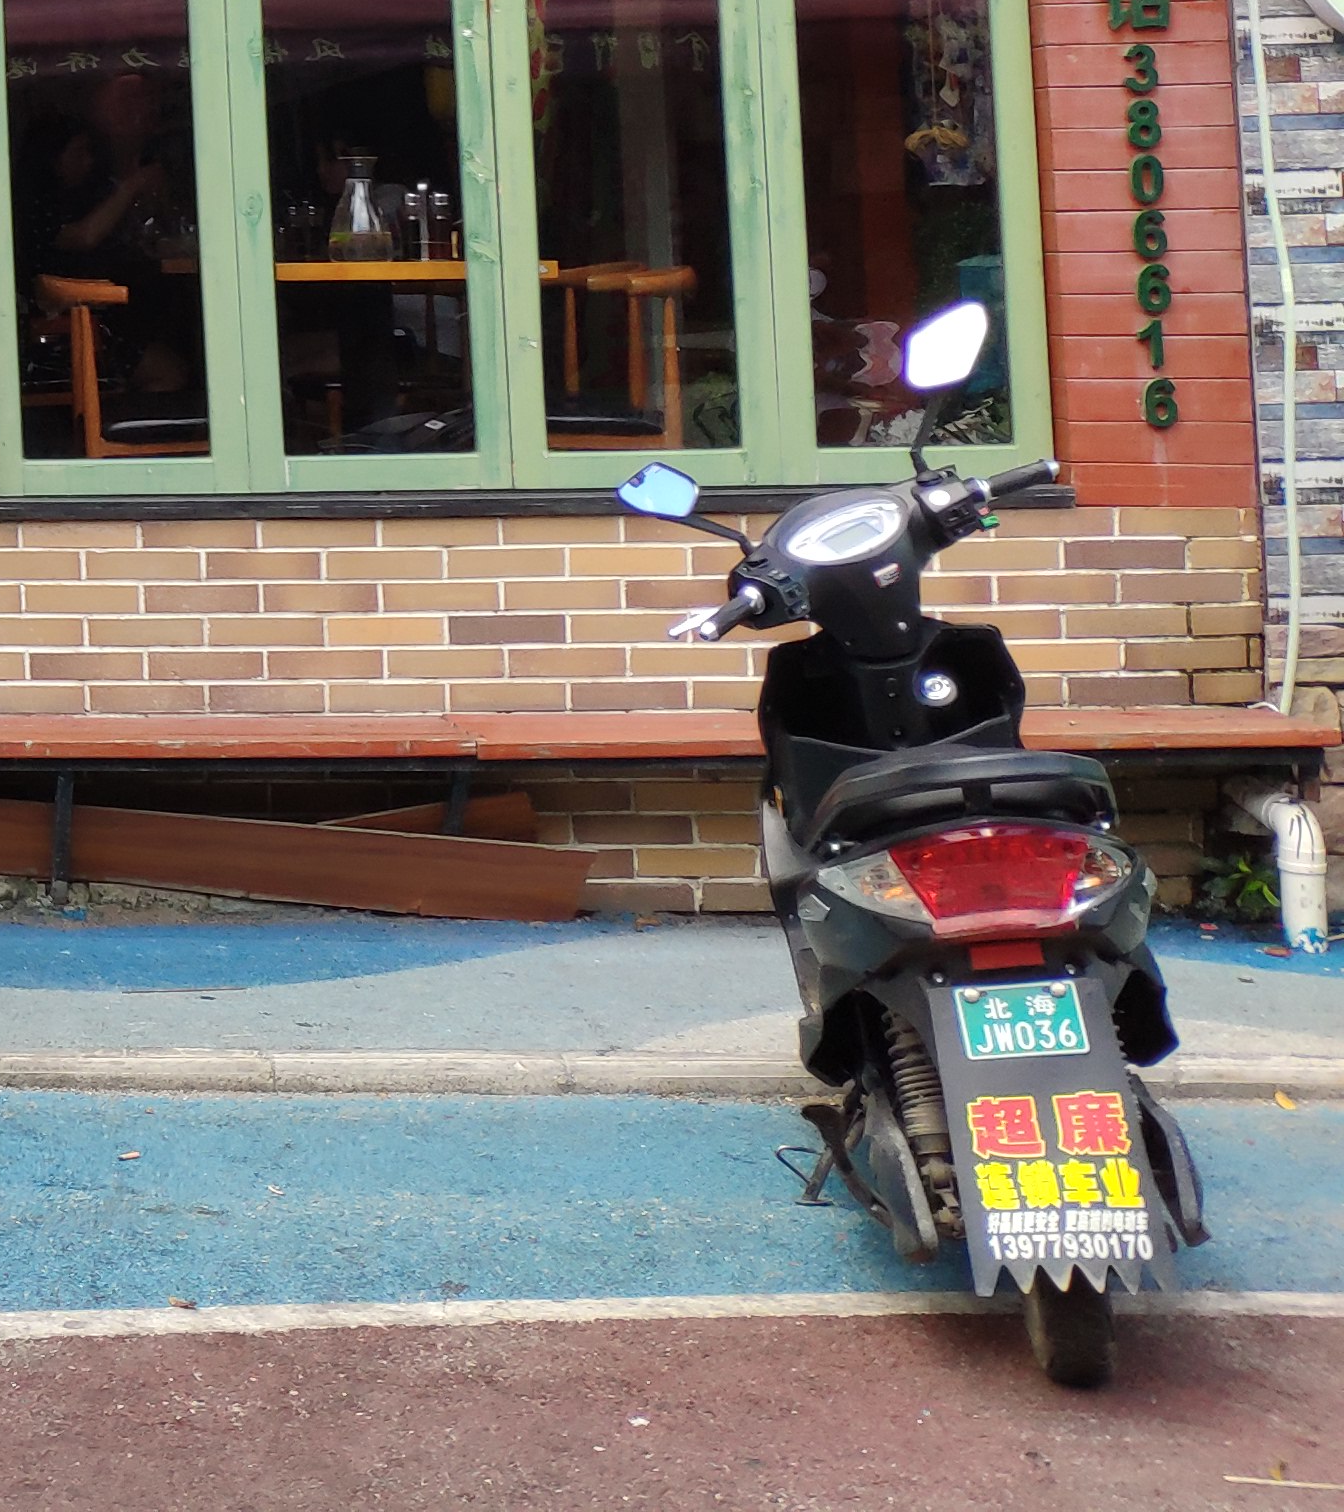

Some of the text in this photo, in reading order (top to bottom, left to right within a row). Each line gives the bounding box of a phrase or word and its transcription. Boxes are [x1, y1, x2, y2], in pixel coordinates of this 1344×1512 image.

[984, 994, 1056, 1020] 北海
[976, 1020, 1078, 1054] JW036
[967, 1091, 1131, 1159] 超廉
[974, 1158, 1145, 1210] 连锁车业
[989, 1233, 1153, 1261] 13977930170
